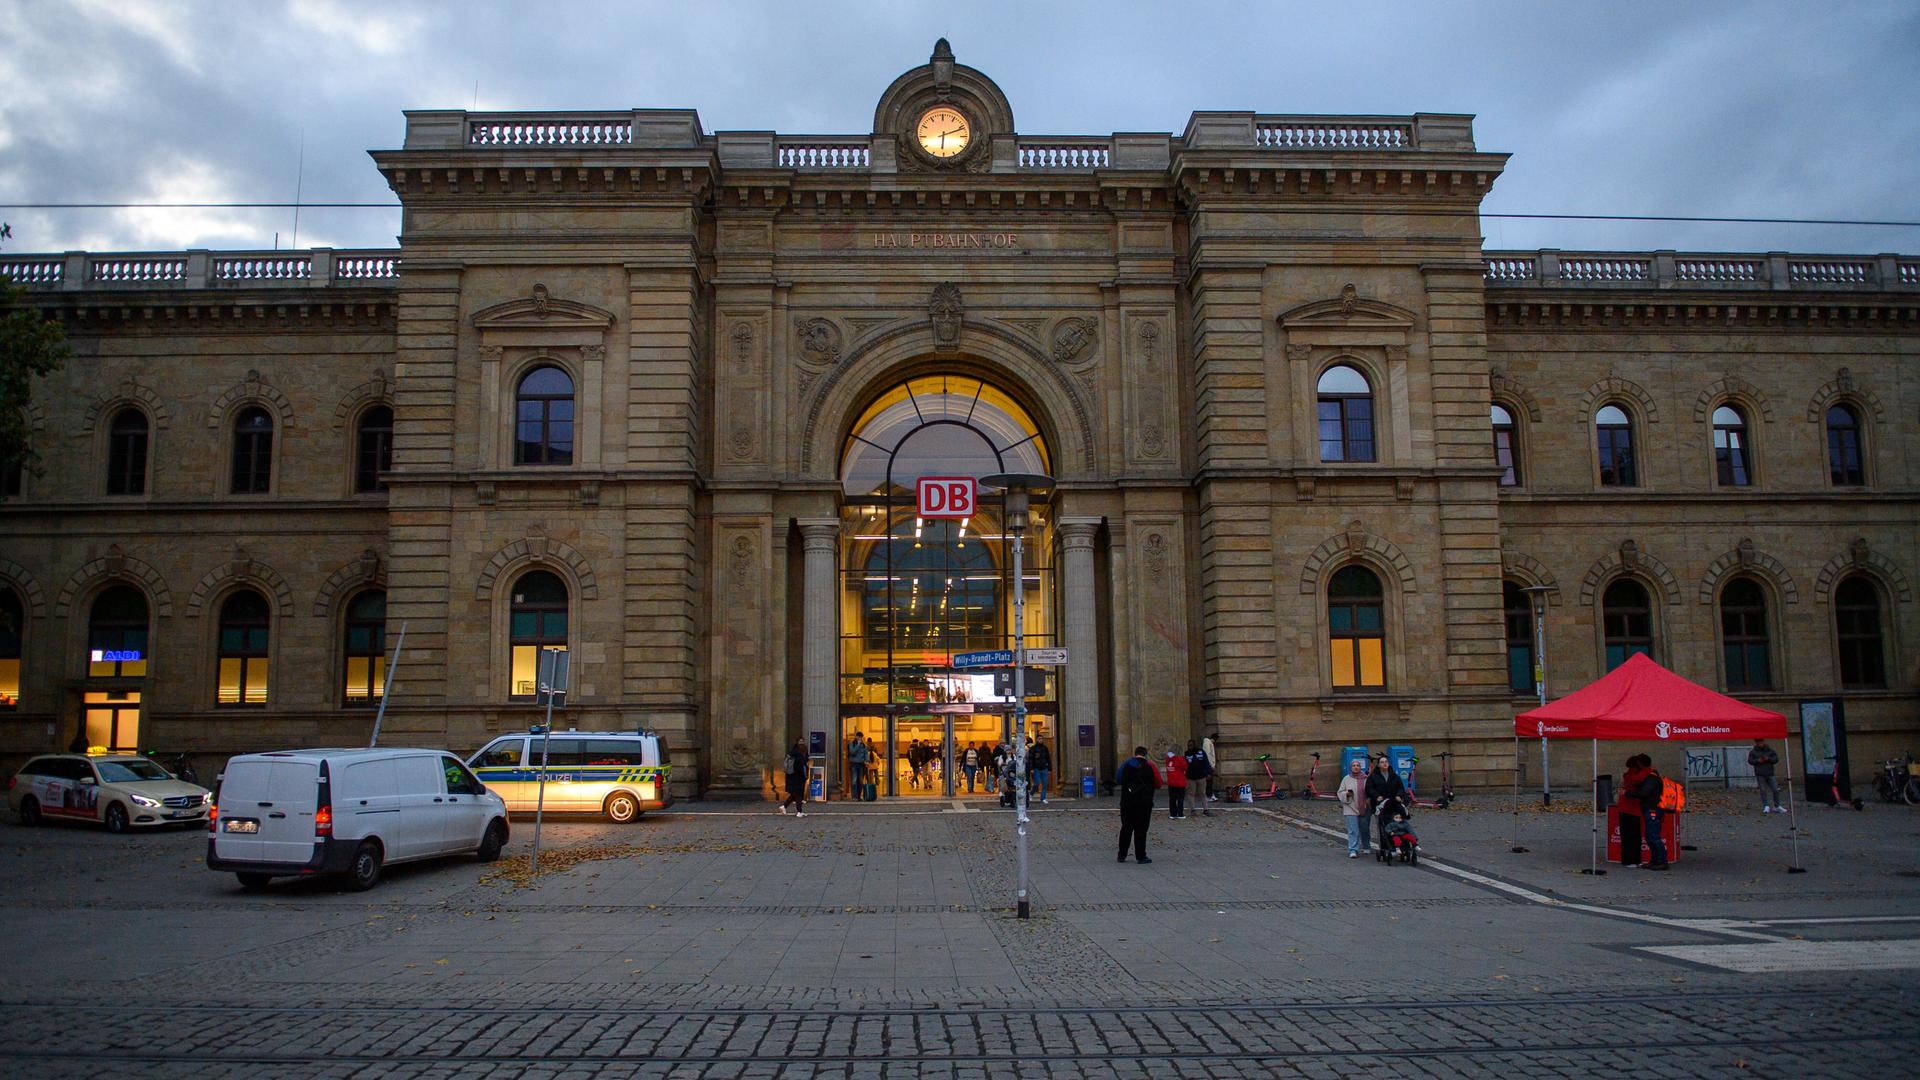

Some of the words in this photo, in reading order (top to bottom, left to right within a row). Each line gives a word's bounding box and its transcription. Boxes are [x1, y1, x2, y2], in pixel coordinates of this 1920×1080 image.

[874, 233, 1017, 248] HAUPTBAHNHOF
[925, 483, 970, 512] DB
[104, 650, 140, 661] ALDI
[955, 652, 1012, 665] Willy-Brandt-Platz
[1672, 726, 1688, 734] Save
[1689, 726, 1701, 734] the
[1701, 726, 1731, 734] Children
[536, 773, 573, 782] POLIZEI
